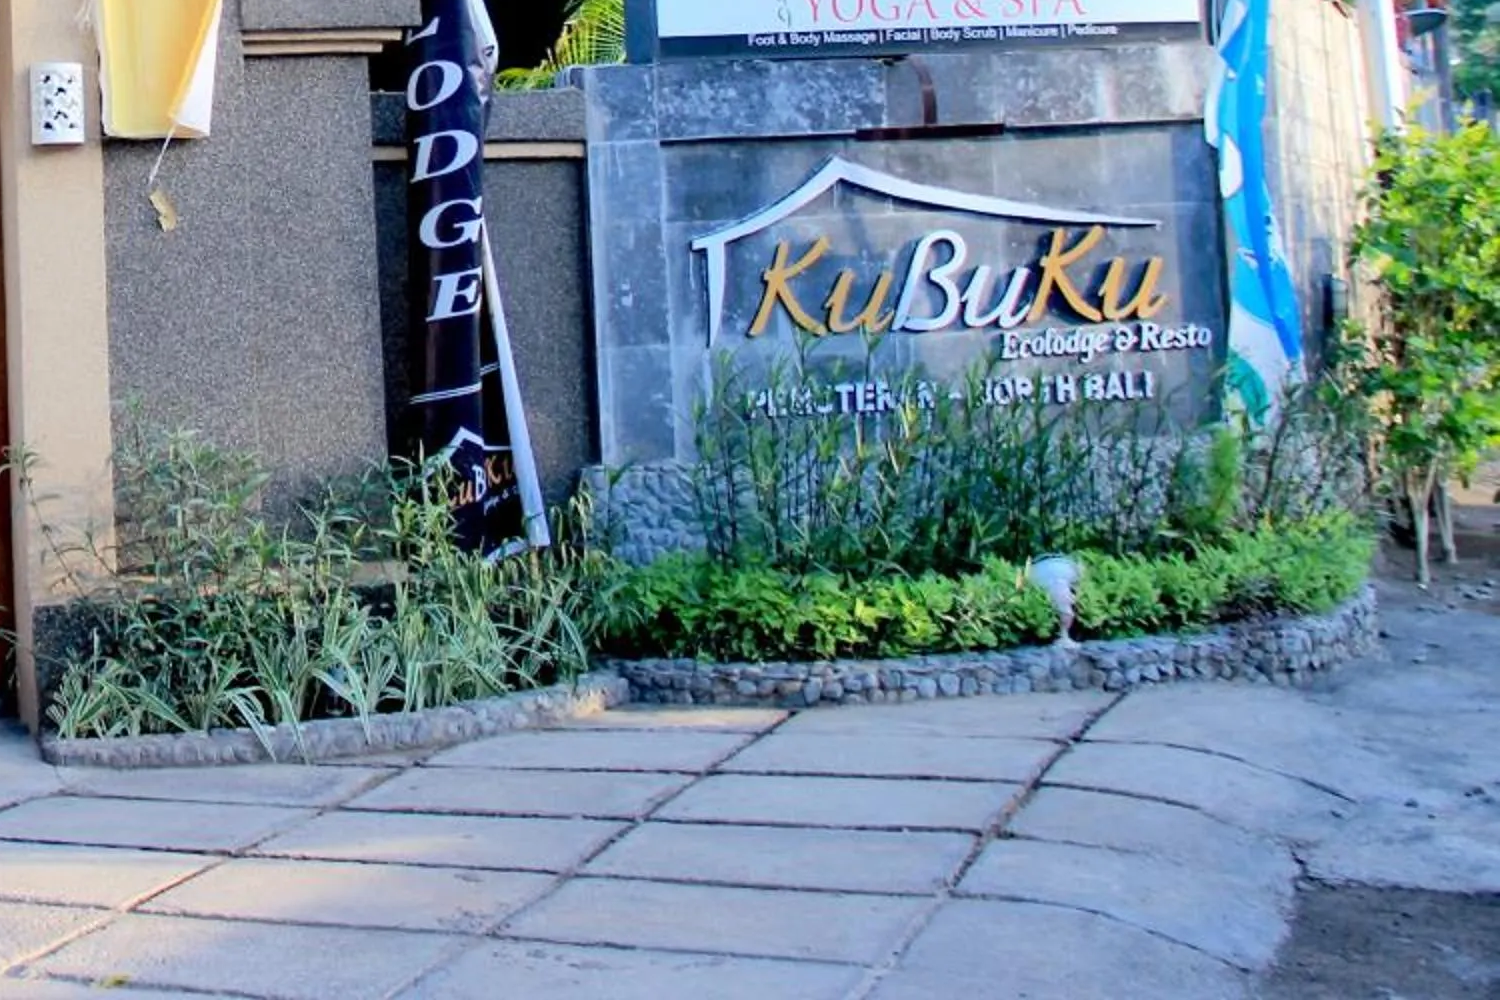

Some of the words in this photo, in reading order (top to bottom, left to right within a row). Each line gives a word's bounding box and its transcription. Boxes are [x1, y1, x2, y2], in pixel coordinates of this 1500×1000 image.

[748, 34, 775, 46] Foot
[778, 34, 786, 45] &
[790, 33, 821, 47] Body
[823, 31, 877, 45] Massage
[886, 29, 921, 41] Facial
[930, 27, 961, 42] Body
[963, 26, 997, 40] Scrub
[1006, 24, 1059, 38] Manicure
[1067, 23, 1119, 36] Pedicure
[1000, 327, 1111, 363] Ecolodge
[1140, 322, 1212, 351] Resto
[1084, 370, 1155, 400] BALI
